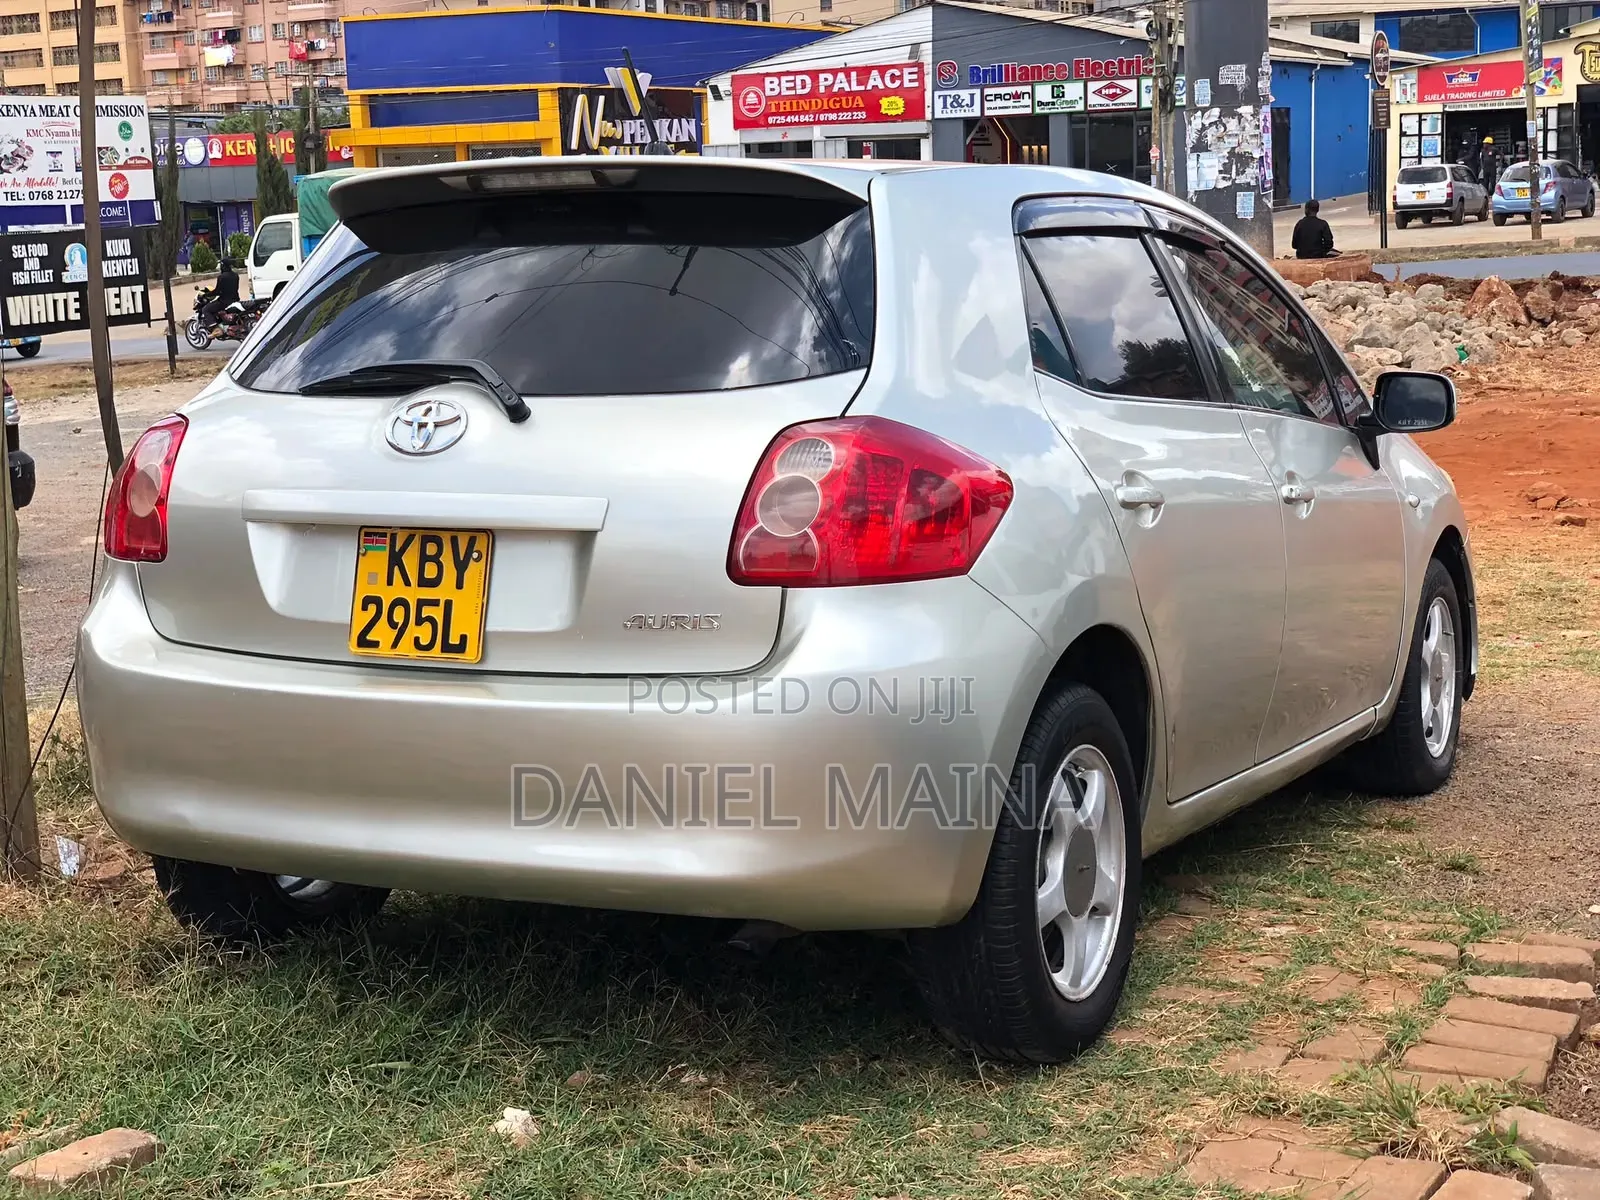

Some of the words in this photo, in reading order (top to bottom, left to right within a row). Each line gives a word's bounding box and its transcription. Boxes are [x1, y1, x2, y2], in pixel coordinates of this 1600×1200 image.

[764, 74, 812, 96] BED
[818, 67, 918, 94] PALACE
[969, 62, 1068, 86] Brilliance
[938, 93, 976, 110] T&J
[1037, 98, 1078, 107] DuraGreen
[1424, 93, 1445, 101] SUELA
[1447, 91, 1476, 100] TRADING
[1478, 89, 1506, 98] LIMITED
[0, 105, 37, 117] KENYA
[38, 105, 70, 117] MEAT
[768, 96, 864, 112] THINDIGUA
[570, 94, 622, 150] New
[26, 129, 44, 138] KMC
[45, 129, 70, 139] Nyama
[226, 137, 296, 156] KENHIC
[24, 176, 58, 188] Affordable!
[3, 191, 25, 201] TEL:
[28, 191, 54, 200] 0768
[12, 245, 27, 258] SEA
[28, 243, 48, 258] FOOD
[105, 239, 131, 257] KUKU
[24, 258, 40, 270] AND
[102, 258, 139, 278] KIENYEJI
[12, 271, 30, 285] FISH
[30, 270, 53, 284] FILLET
[6, 291, 81, 326] WHITE
[104, 285, 144, 316] EAT
[386, 532, 477, 590] KBY
[357, 595, 468, 654] 295L
[623, 614, 721, 631] AURIS
